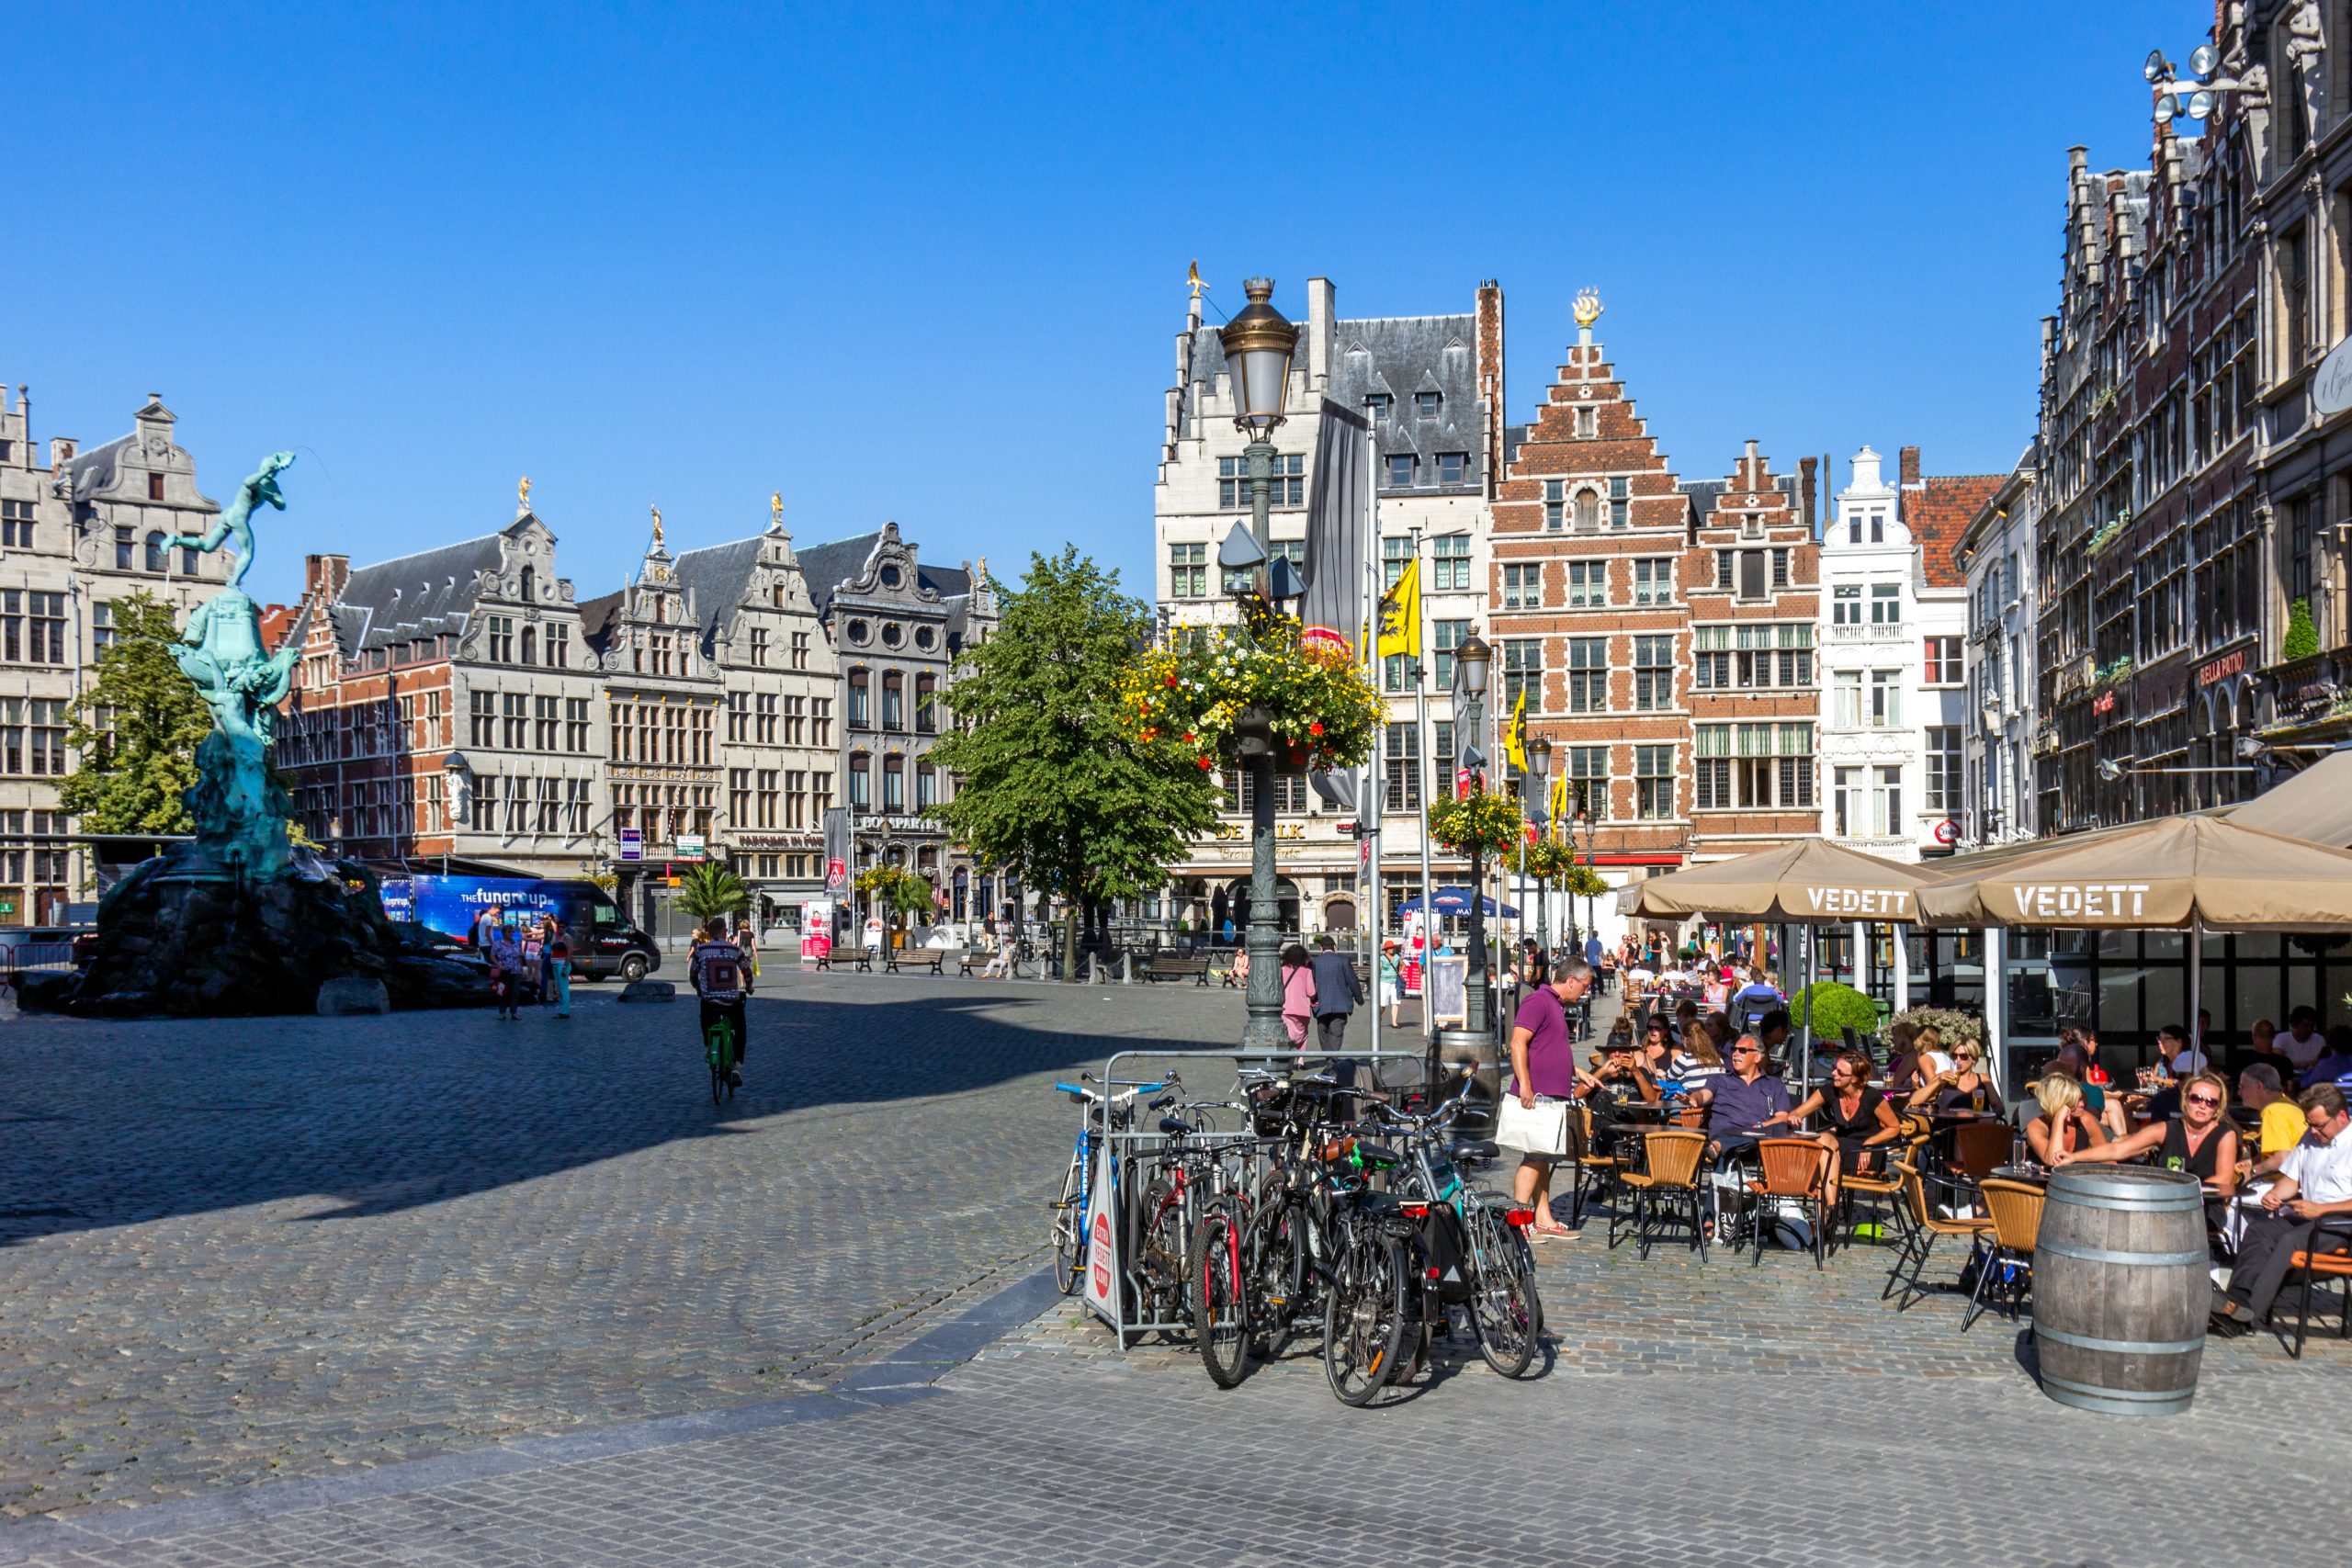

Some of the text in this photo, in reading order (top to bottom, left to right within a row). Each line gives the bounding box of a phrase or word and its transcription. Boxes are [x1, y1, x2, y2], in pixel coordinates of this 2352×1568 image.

[2199, 650, 2245, 686] BELLA PATIO
[862, 816, 935, 831] BOAPARTE
[1290, 865, 1323, 874] BRASSERIE
[1807, 887, 1909, 914] VEDETT
[2013, 885, 2149, 916] VEDETT
[1096, 1224, 1109, 1243] EXTRA
[1095, 1244, 1111, 1269] VEDETT
[1096, 1268, 1109, 1288] BLOND
